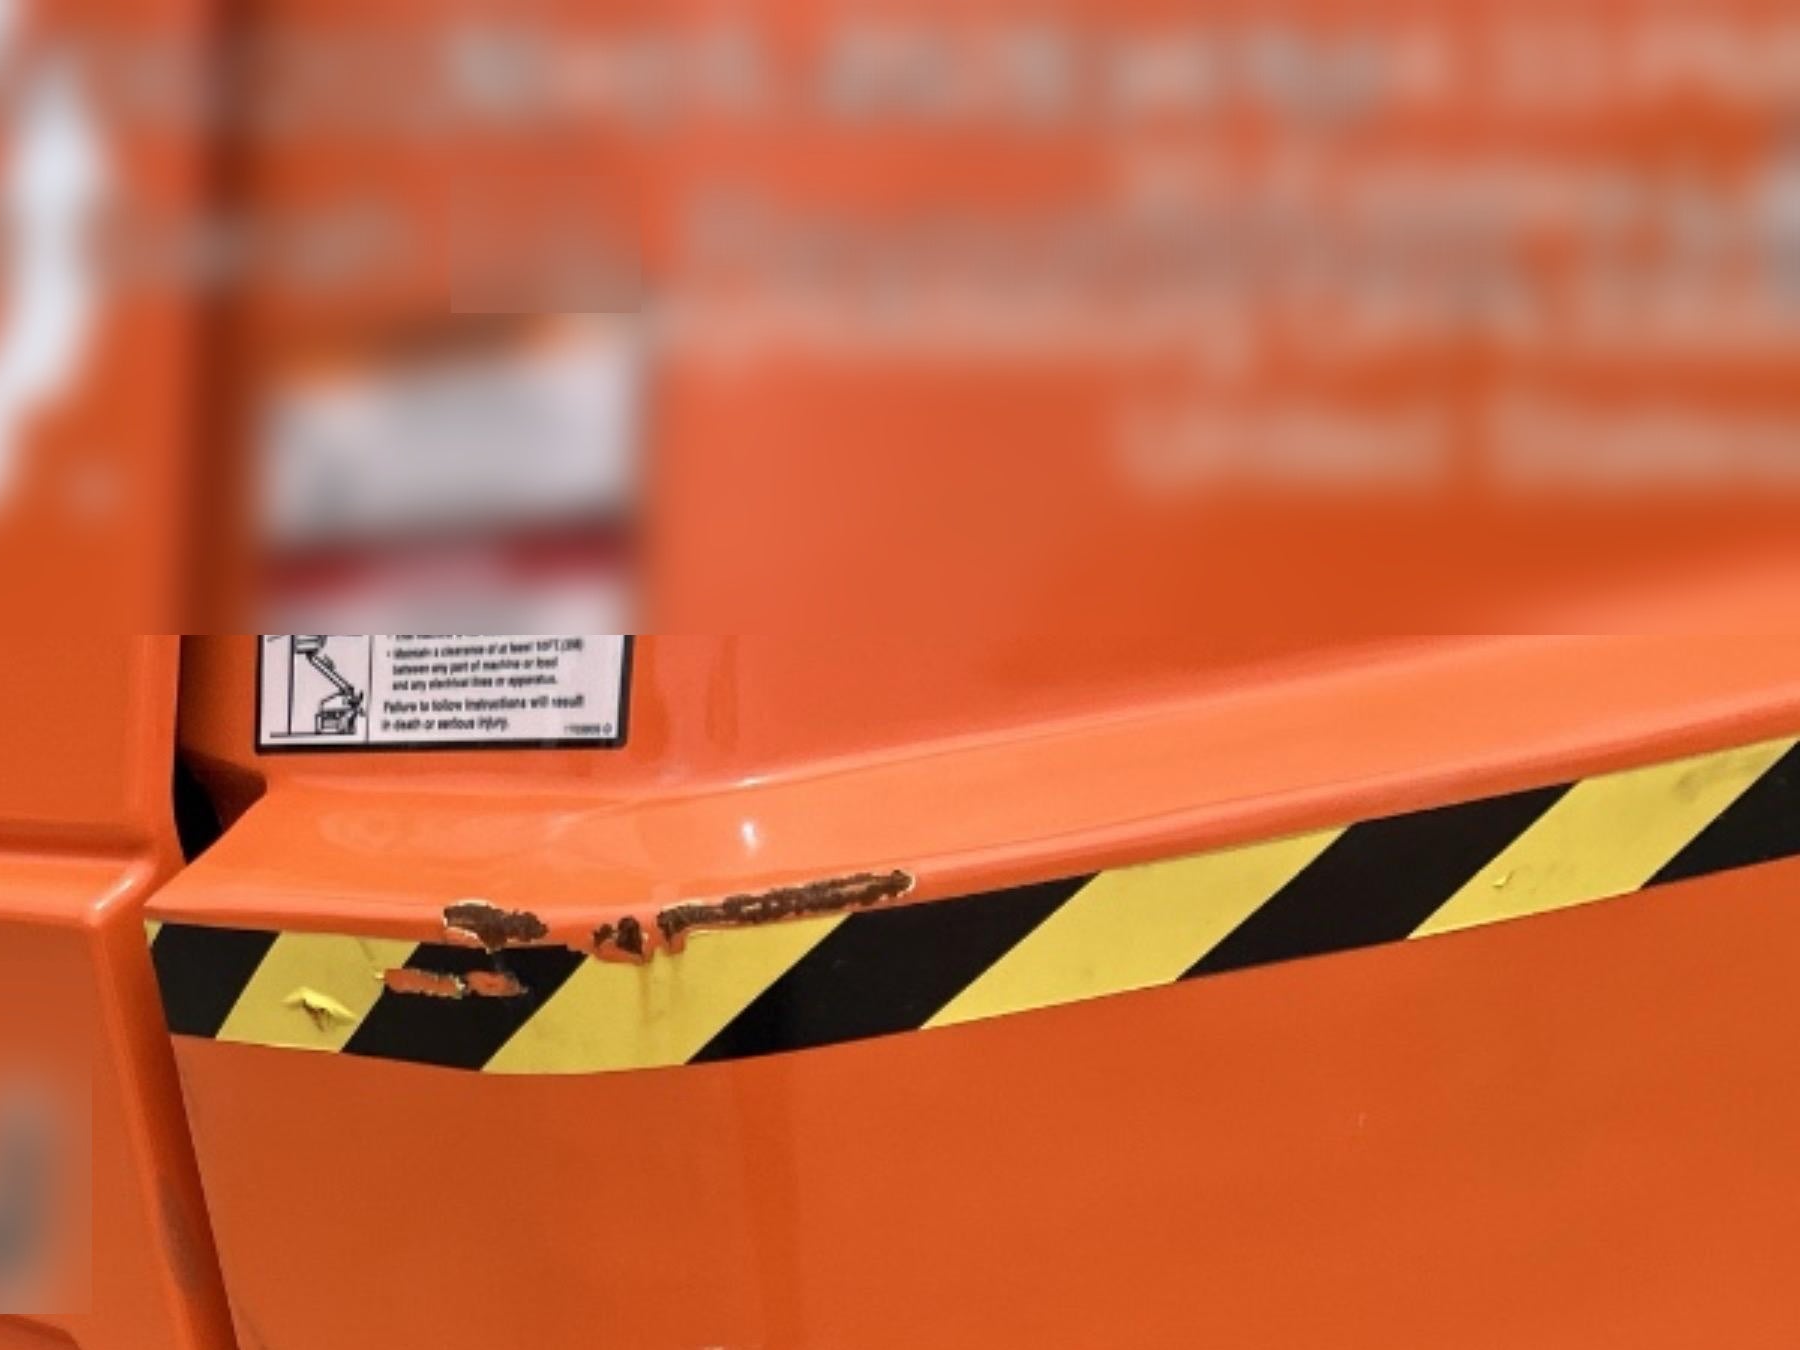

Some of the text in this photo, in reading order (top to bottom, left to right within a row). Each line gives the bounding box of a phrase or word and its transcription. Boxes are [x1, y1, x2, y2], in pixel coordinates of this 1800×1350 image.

[441, 646, 483, 657] clearance
[488, 644, 497, 655] of
[498, 643, 507, 654] at
[509, 641, 532, 653] least
[393, 657, 558, 676] between any part of machine or load
[393, 680, 408, 690] and
[410, 681, 426, 691] any
[429, 678, 468, 690] electrical
[471, 677, 492, 688] lines
[495, 677, 504, 686] or
[384, 694, 584, 713] Failure to follow instructions will result
[382, 719, 390, 731] in
[393, 718, 420, 730] death
[425, 719, 435, 729] or
[438, 717, 474, 730] serious
